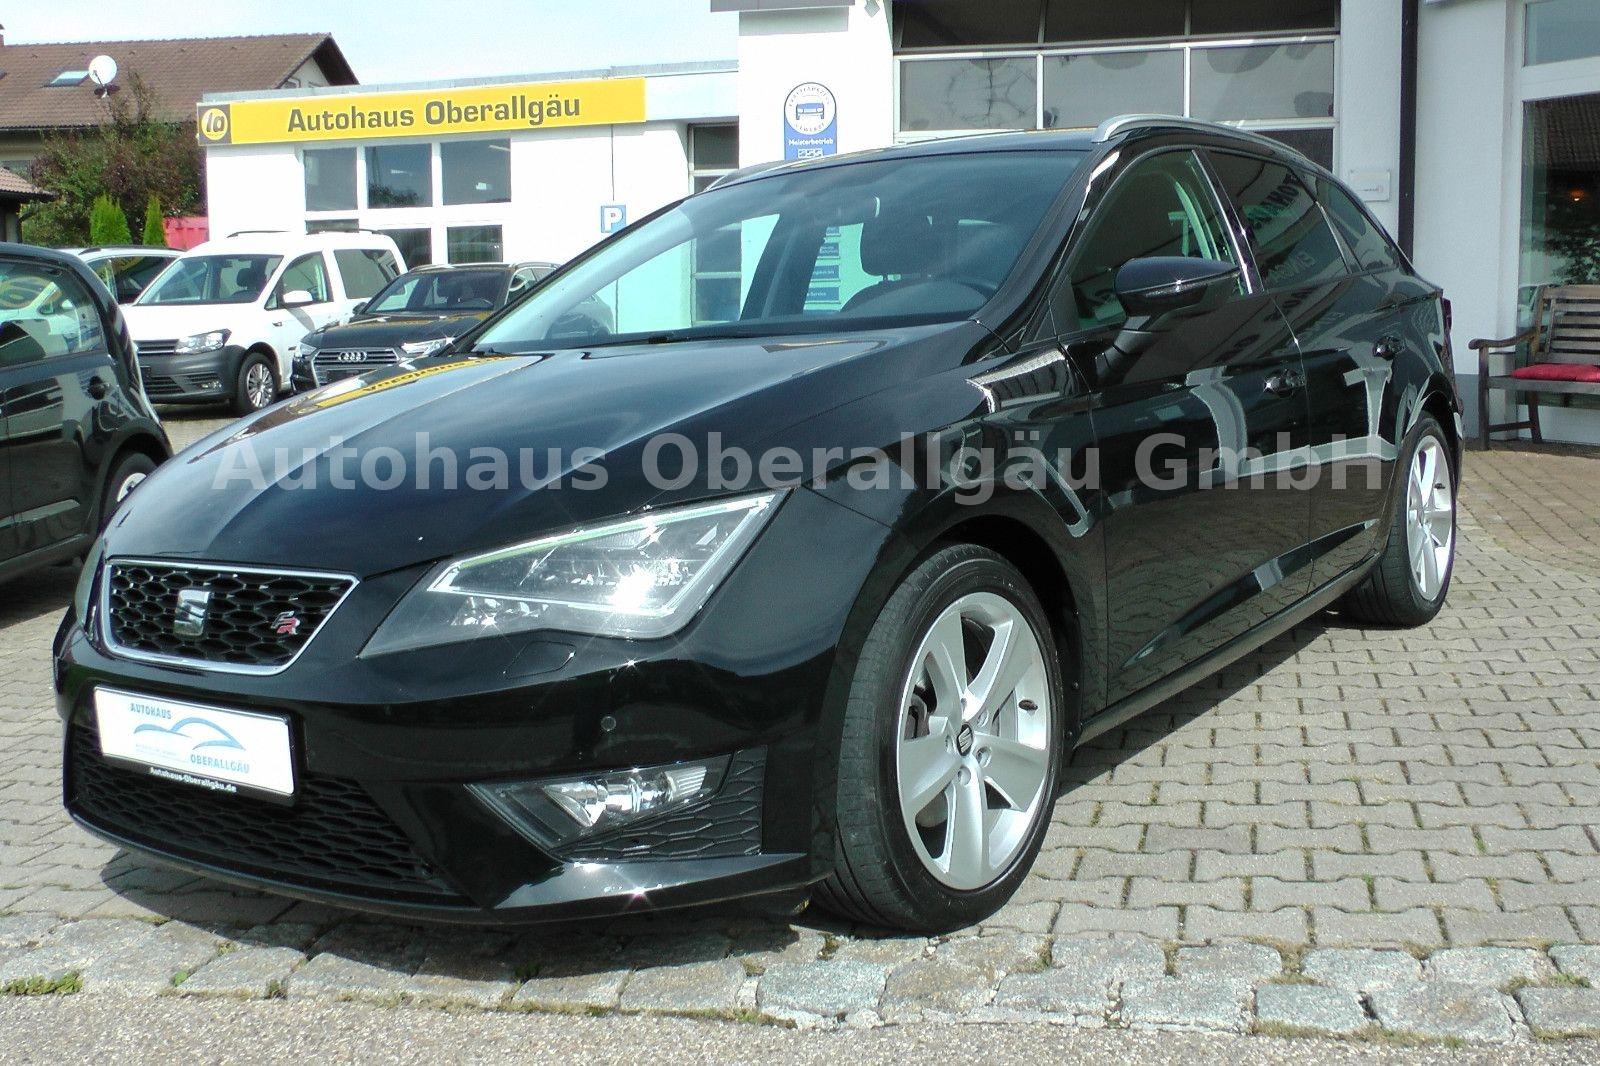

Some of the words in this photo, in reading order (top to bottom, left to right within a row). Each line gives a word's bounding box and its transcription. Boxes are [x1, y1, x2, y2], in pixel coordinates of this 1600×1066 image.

[288, 106, 415, 132] Autohaus
[425, 93, 580, 126] Oberallgäu
[604, 207, 623, 231] P
[130, 702, 172, 720] AUTOHAUS
[190, 753, 250, 774] OBERALLGÄU
